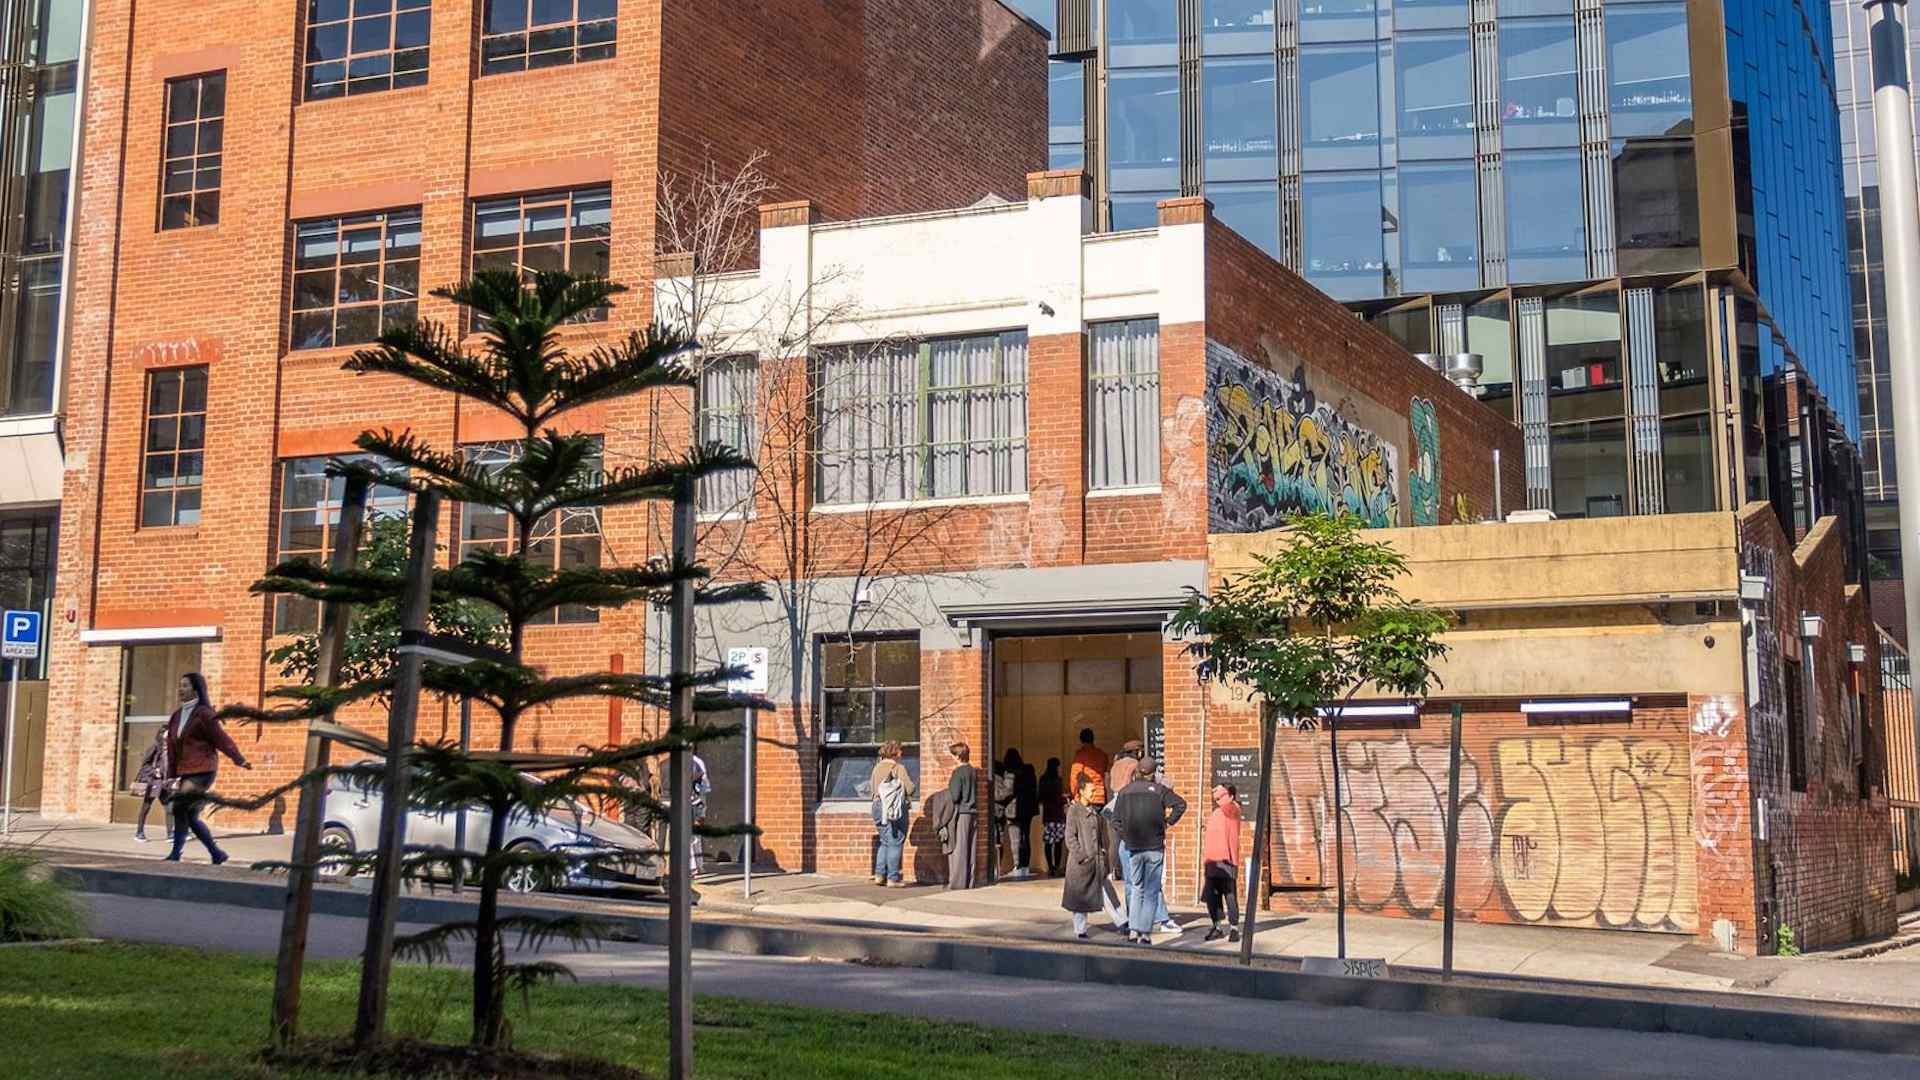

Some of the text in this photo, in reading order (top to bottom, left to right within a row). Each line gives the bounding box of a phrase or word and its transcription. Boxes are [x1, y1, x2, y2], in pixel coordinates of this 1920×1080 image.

[13, 617, 31, 638] P
[731, 652, 745, 662] 2P
[1231, 687, 1243, 700] 19
